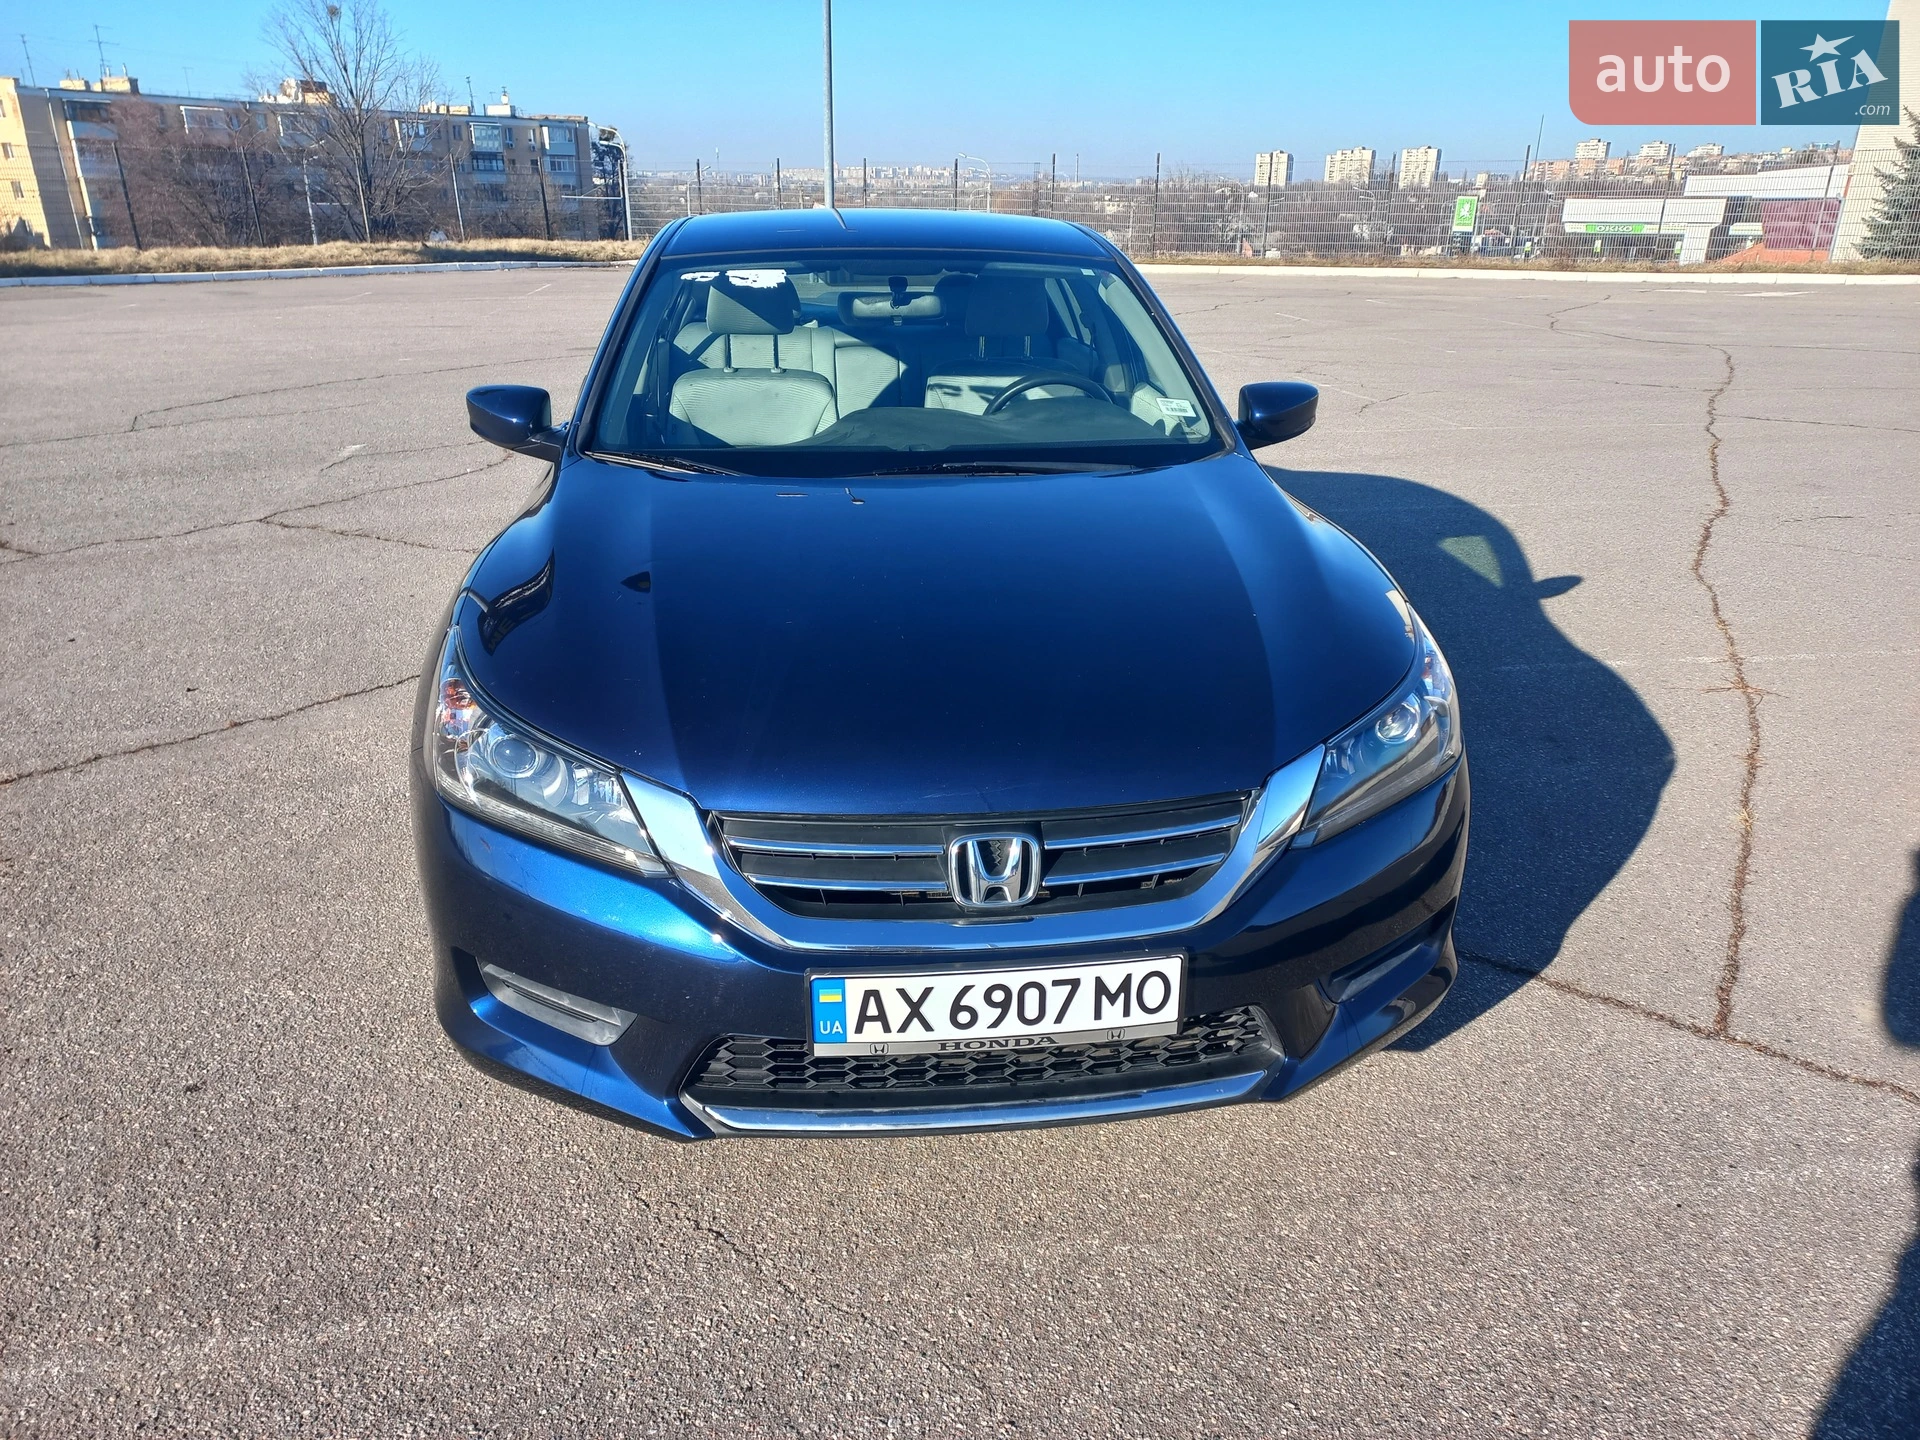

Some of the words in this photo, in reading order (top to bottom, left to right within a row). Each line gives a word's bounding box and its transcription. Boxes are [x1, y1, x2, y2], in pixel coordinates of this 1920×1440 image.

[1596, 225, 1634, 233] OKKO
[854, 986, 934, 1034] AX
[949, 978, 1081, 1030] 6907
[1094, 970, 1172, 1021] MO
[820, 1020, 843, 1035] UA
[938, 1036, 1059, 1051] HONDA
